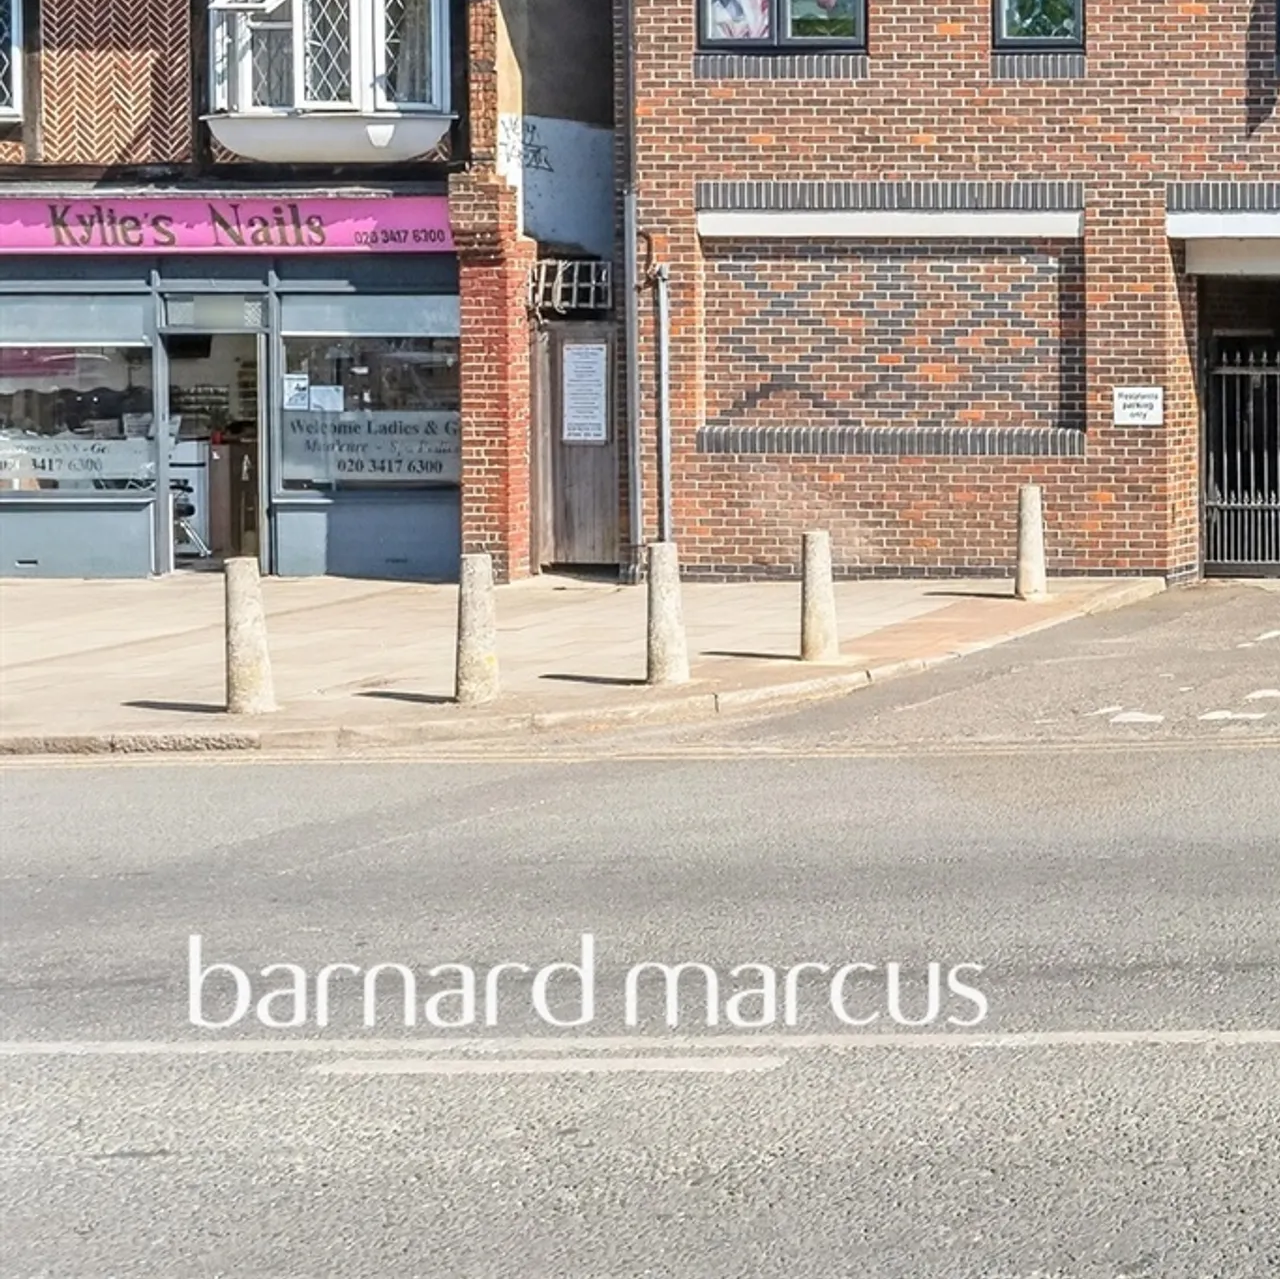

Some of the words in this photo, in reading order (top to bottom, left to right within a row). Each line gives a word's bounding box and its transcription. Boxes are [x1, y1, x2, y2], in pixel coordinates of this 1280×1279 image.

[48, 203, 176, 247] Kylie's
[208, 202, 327, 247] Nails
[354, 231, 379, 245] 020
[381, 229, 409, 244] 3417
[290, 419, 361, 435] Welcome
[367, 420, 420, 435] Ladies
[424, 420, 438, 435] &
[337, 458, 364, 473] 020
[368, 458, 403, 473] 3417
[407, 458, 443, 474] 6300
